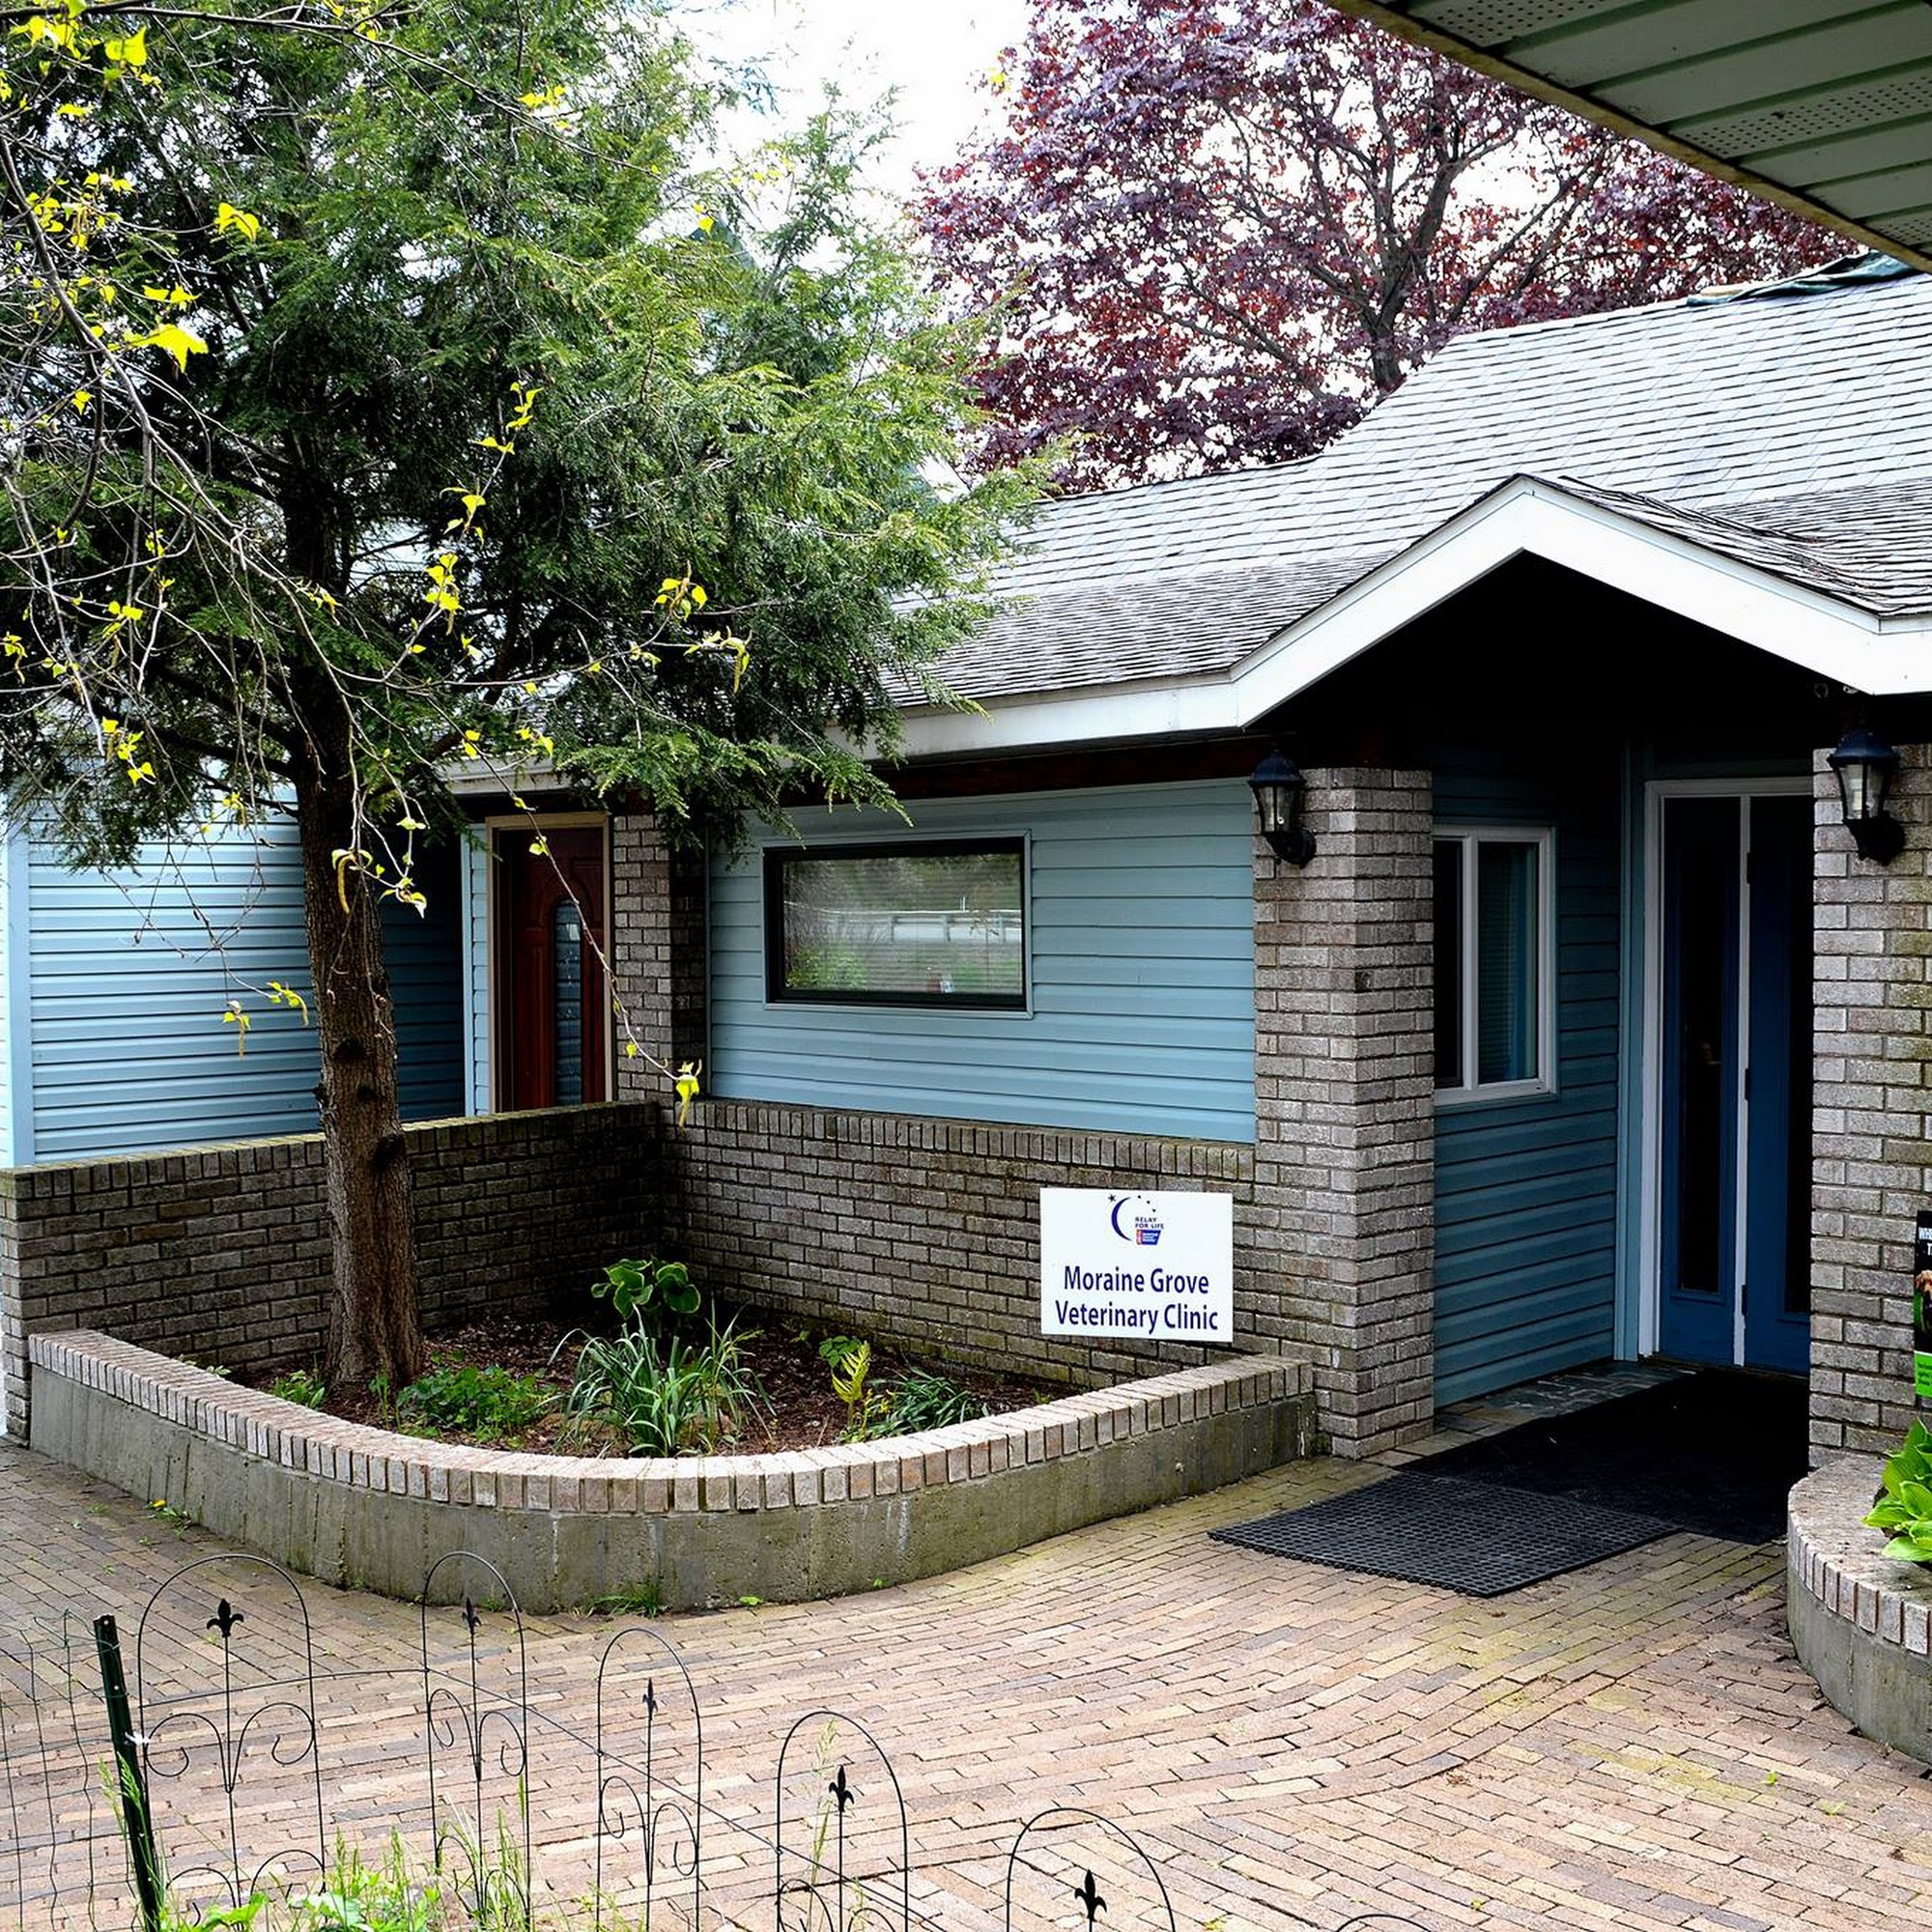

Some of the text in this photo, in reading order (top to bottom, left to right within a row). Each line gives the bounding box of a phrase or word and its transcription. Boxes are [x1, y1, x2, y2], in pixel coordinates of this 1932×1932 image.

[1064, 1265, 1209, 1294] Moraine Grove
[1056, 1299, 1218, 1335] Veterinary Clinic
